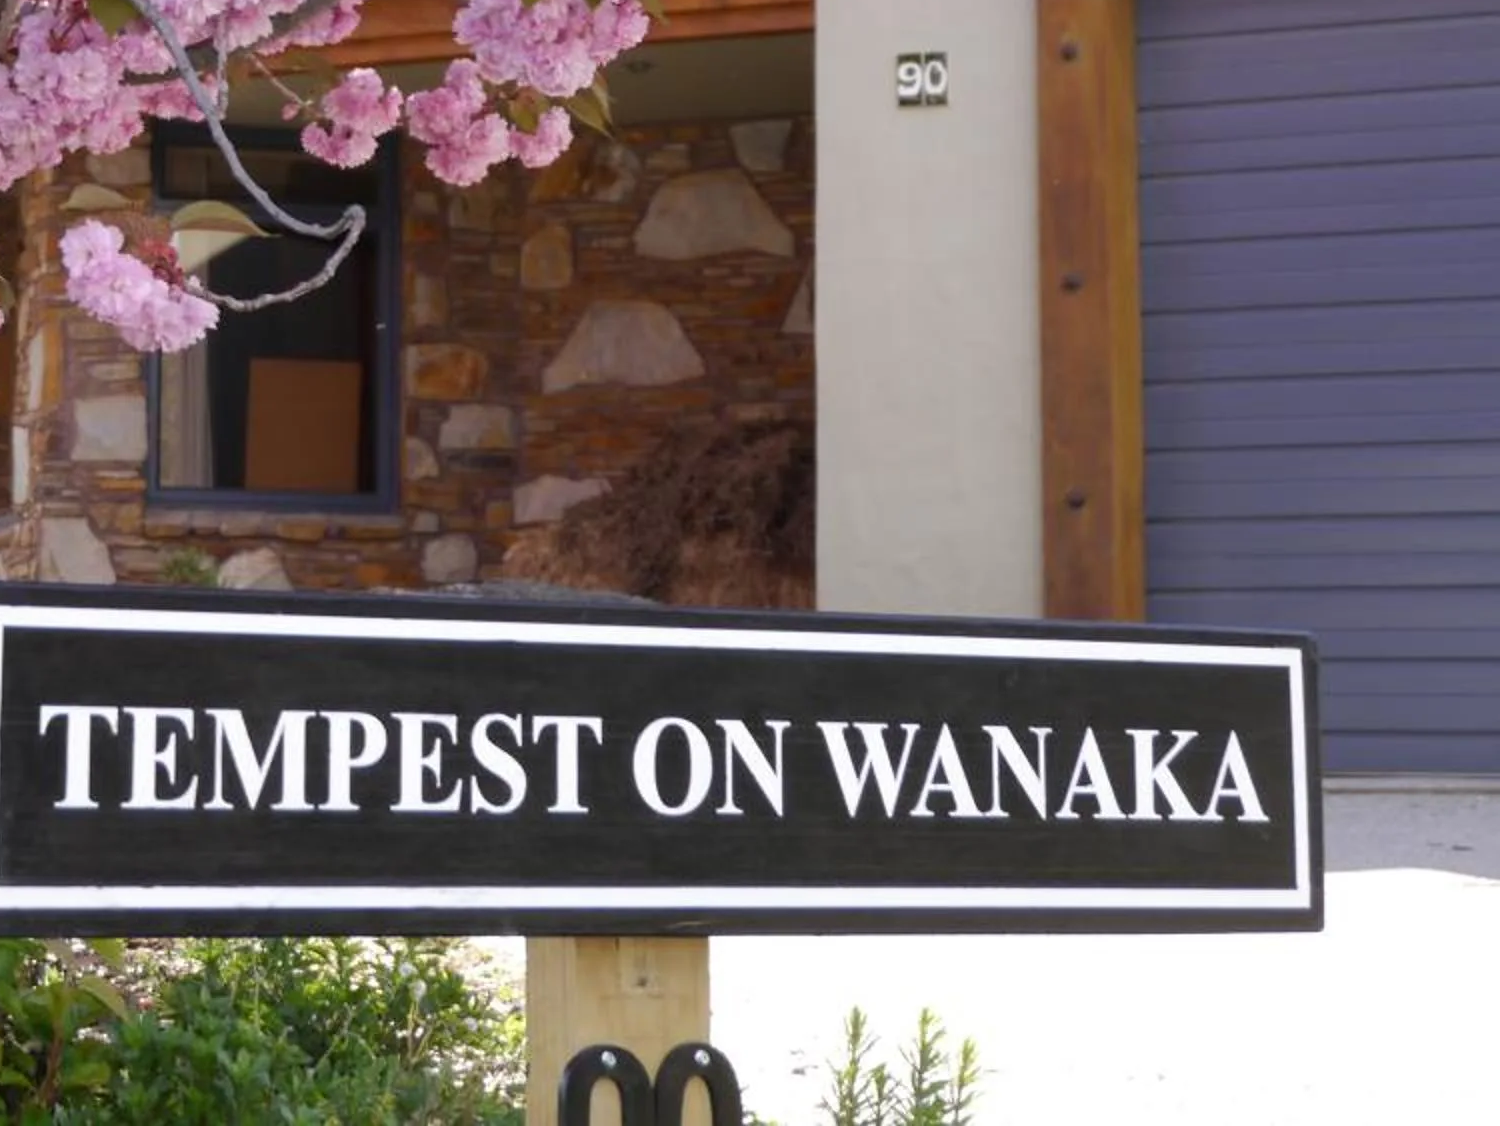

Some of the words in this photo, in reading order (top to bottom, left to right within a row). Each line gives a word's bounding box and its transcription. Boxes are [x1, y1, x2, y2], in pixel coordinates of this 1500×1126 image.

[898, 61, 948, 96] 90
[38, 704, 604, 815] TEMPEST
[631, 716, 792, 818] ON
[815, 721, 1271, 824] WANAKA
